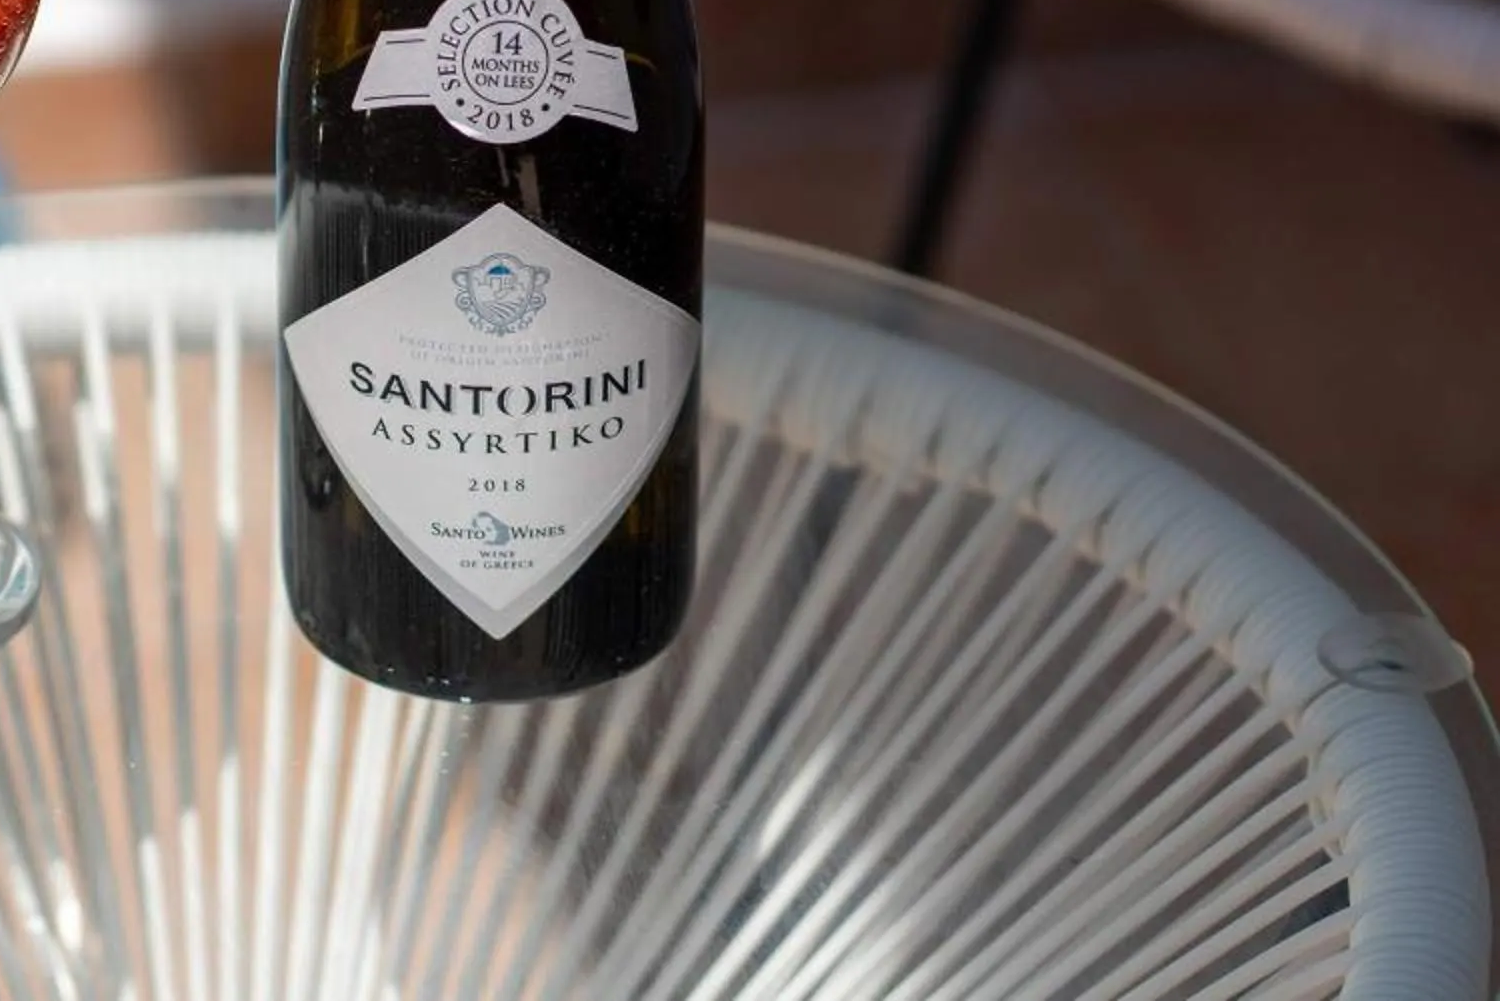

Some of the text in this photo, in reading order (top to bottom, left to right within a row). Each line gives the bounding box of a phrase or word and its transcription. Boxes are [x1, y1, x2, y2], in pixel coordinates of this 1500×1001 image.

[492, 31, 523, 55] 14
[471, 58, 540, 72] MONTHS
[541, 13, 576, 99] CUVÉE
[475, 73, 535, 89] ON LEES
[467, 104, 535, 131] 2018
[350, 359, 647, 417] SANTORINI
[372, 416, 624, 454] ASSYRTIKO
[468, 478, 526, 492] 2018
[479, 550, 515, 558] WINE
[460, 560, 534, 569] OF GREECE
